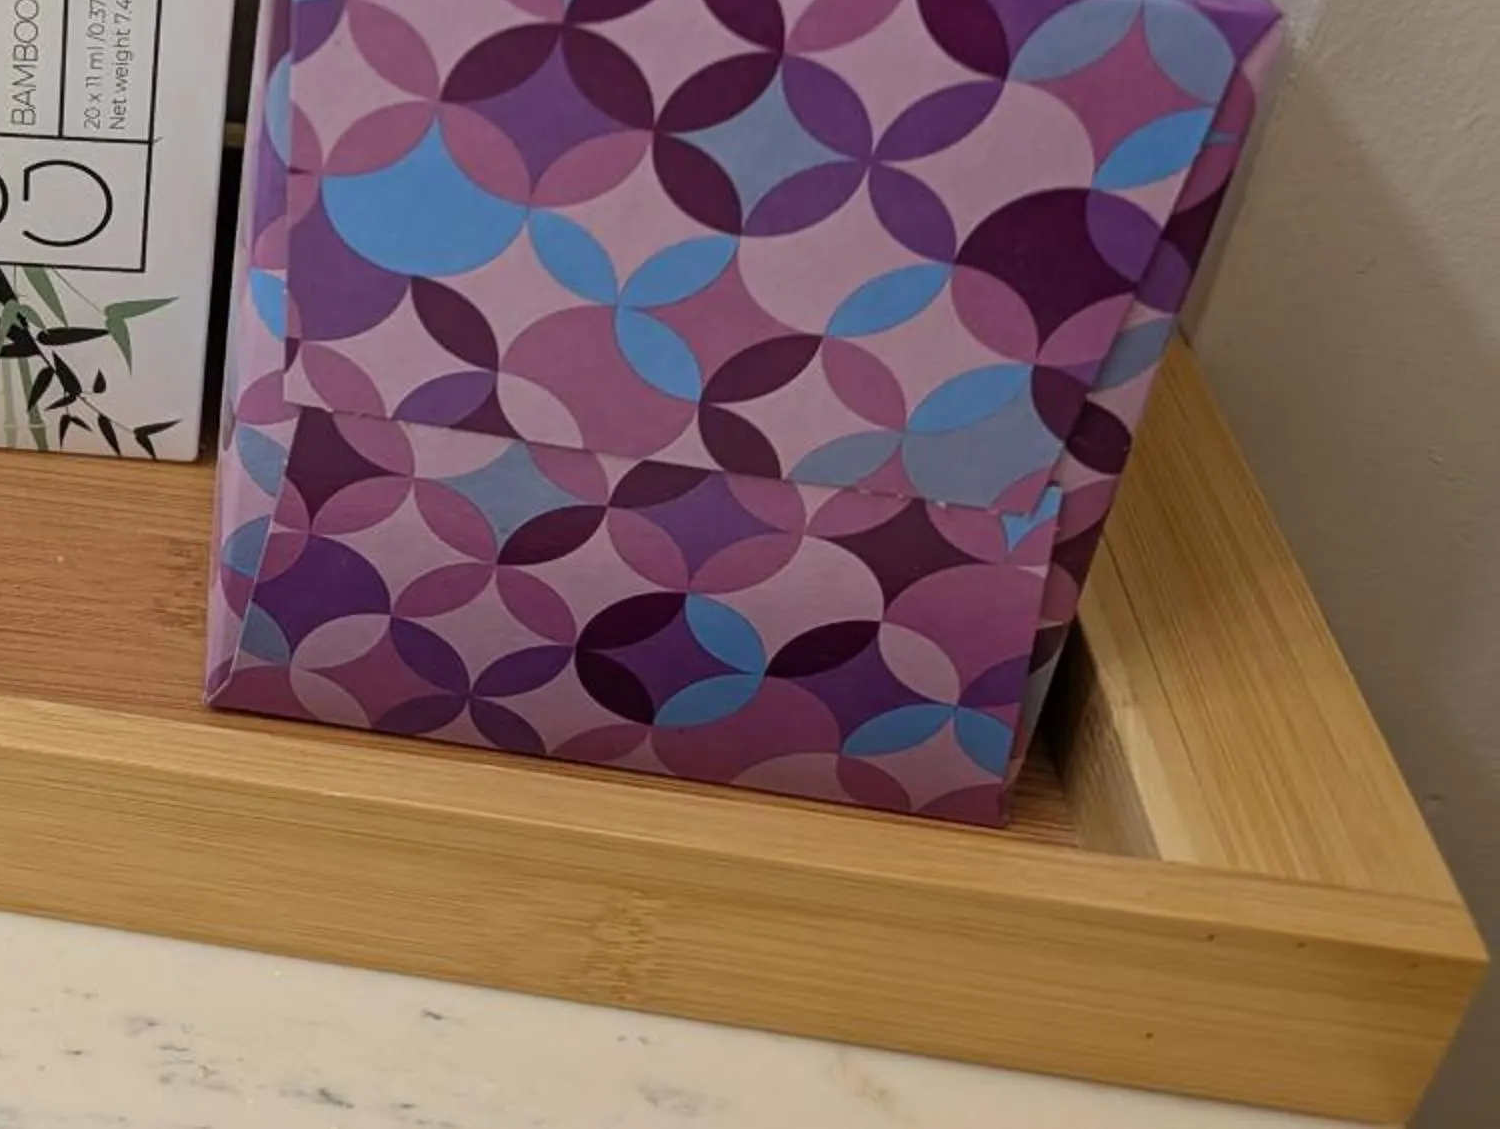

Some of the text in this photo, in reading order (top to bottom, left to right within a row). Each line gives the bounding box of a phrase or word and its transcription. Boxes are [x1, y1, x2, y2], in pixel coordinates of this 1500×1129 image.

[85, 46, 104, 70] ml
[112, 28, 133, 93] weight
[84, 76, 102, 88] 11
[88, 92, 102, 102] x
[83, 106, 101, 131] 20
[108, 98, 127, 130] Net
